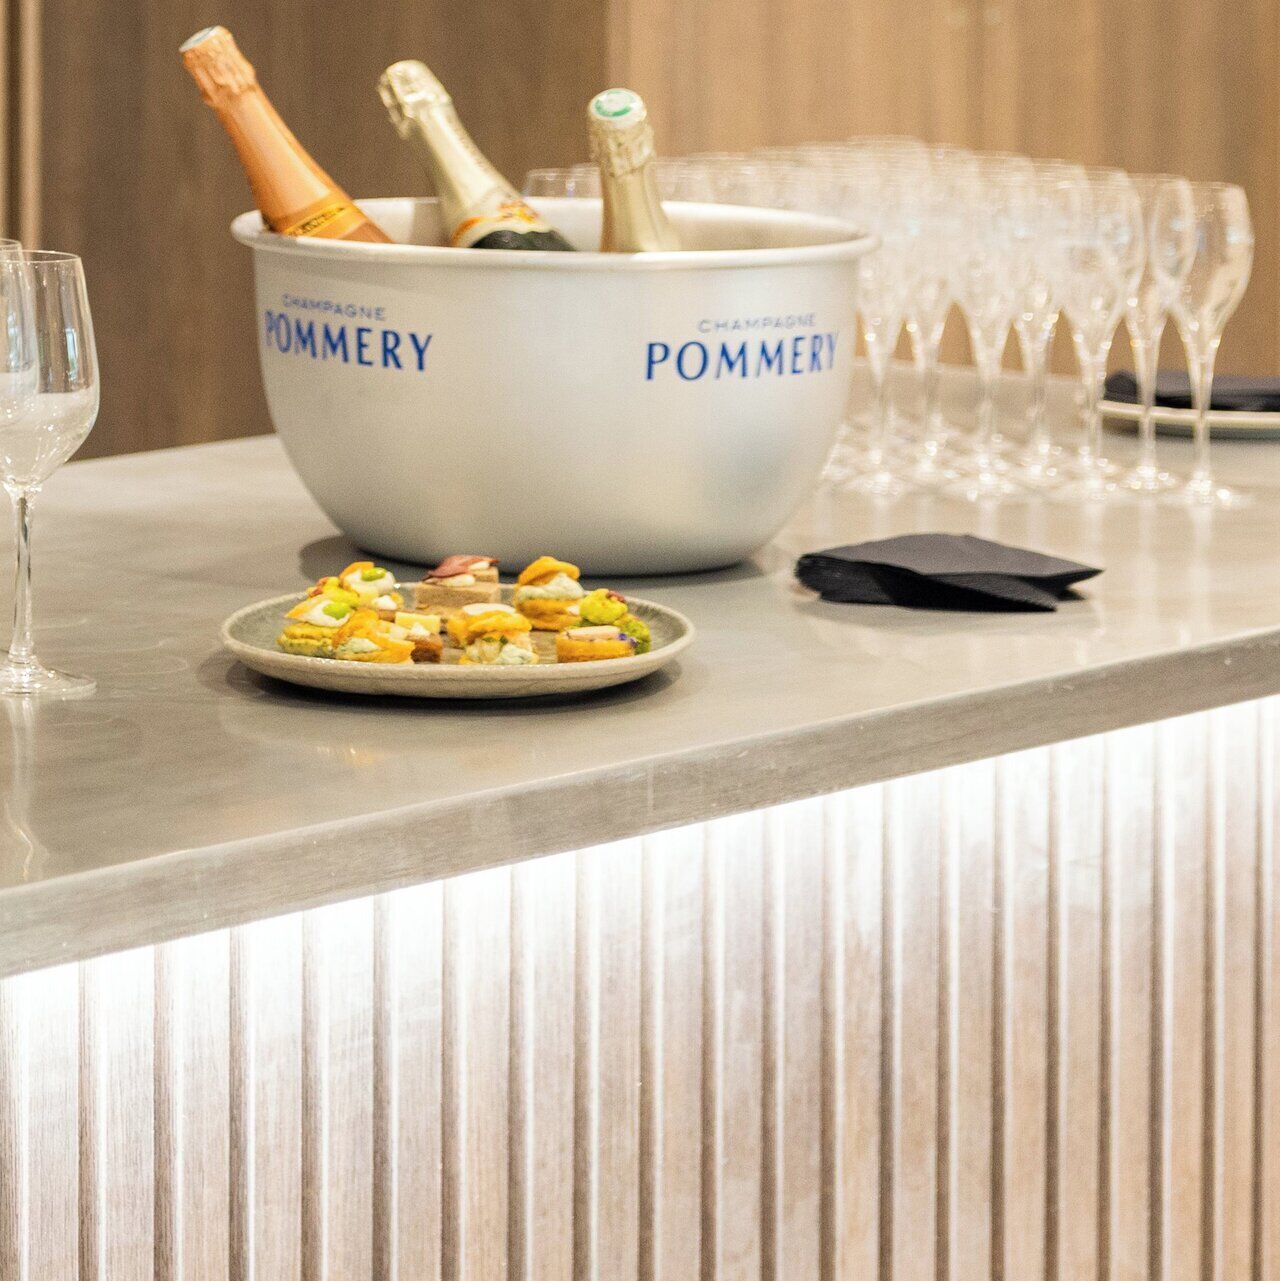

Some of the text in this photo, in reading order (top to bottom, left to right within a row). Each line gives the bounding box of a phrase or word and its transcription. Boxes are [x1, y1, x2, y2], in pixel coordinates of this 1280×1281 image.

[282, 293, 387, 321] CHAMPAGNE
[698, 312, 816, 334] CHAMPAGNE
[264, 308, 433, 372] POMMERY
[645, 326, 840, 381] POMMERY
